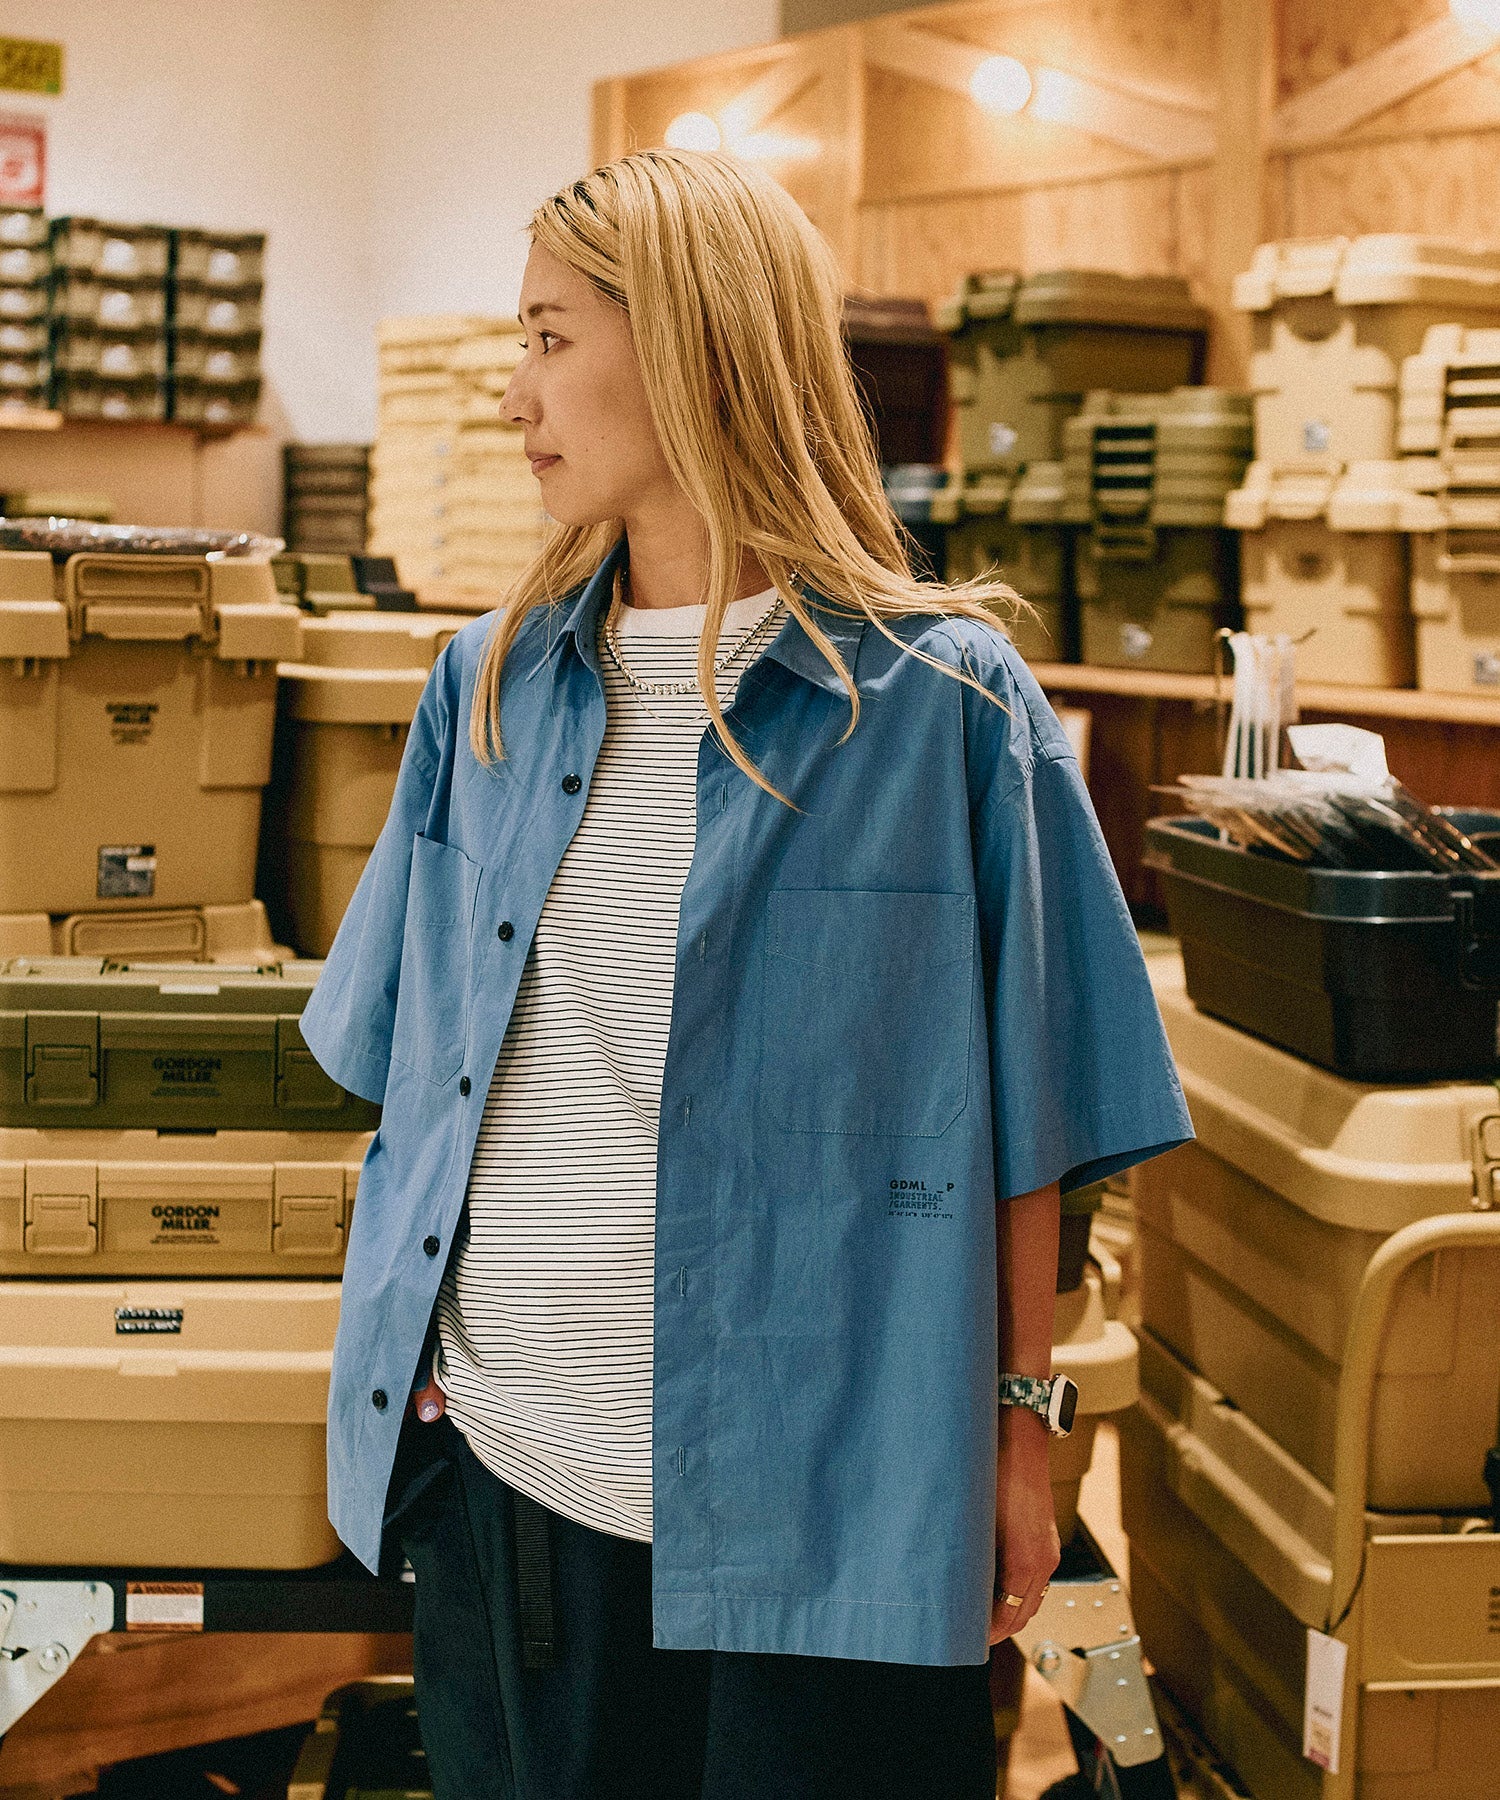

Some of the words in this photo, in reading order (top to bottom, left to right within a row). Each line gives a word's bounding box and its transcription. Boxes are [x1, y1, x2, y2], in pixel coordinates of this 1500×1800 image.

[153, 1056, 222, 1070] GORDON
[889, 1179, 927, 1191] GDML
[889, 1191, 944, 1202] INDUSTRIAL
[151, 1205, 220, 1218] GORDON
[145, 1584, 199, 1594] WARNING
